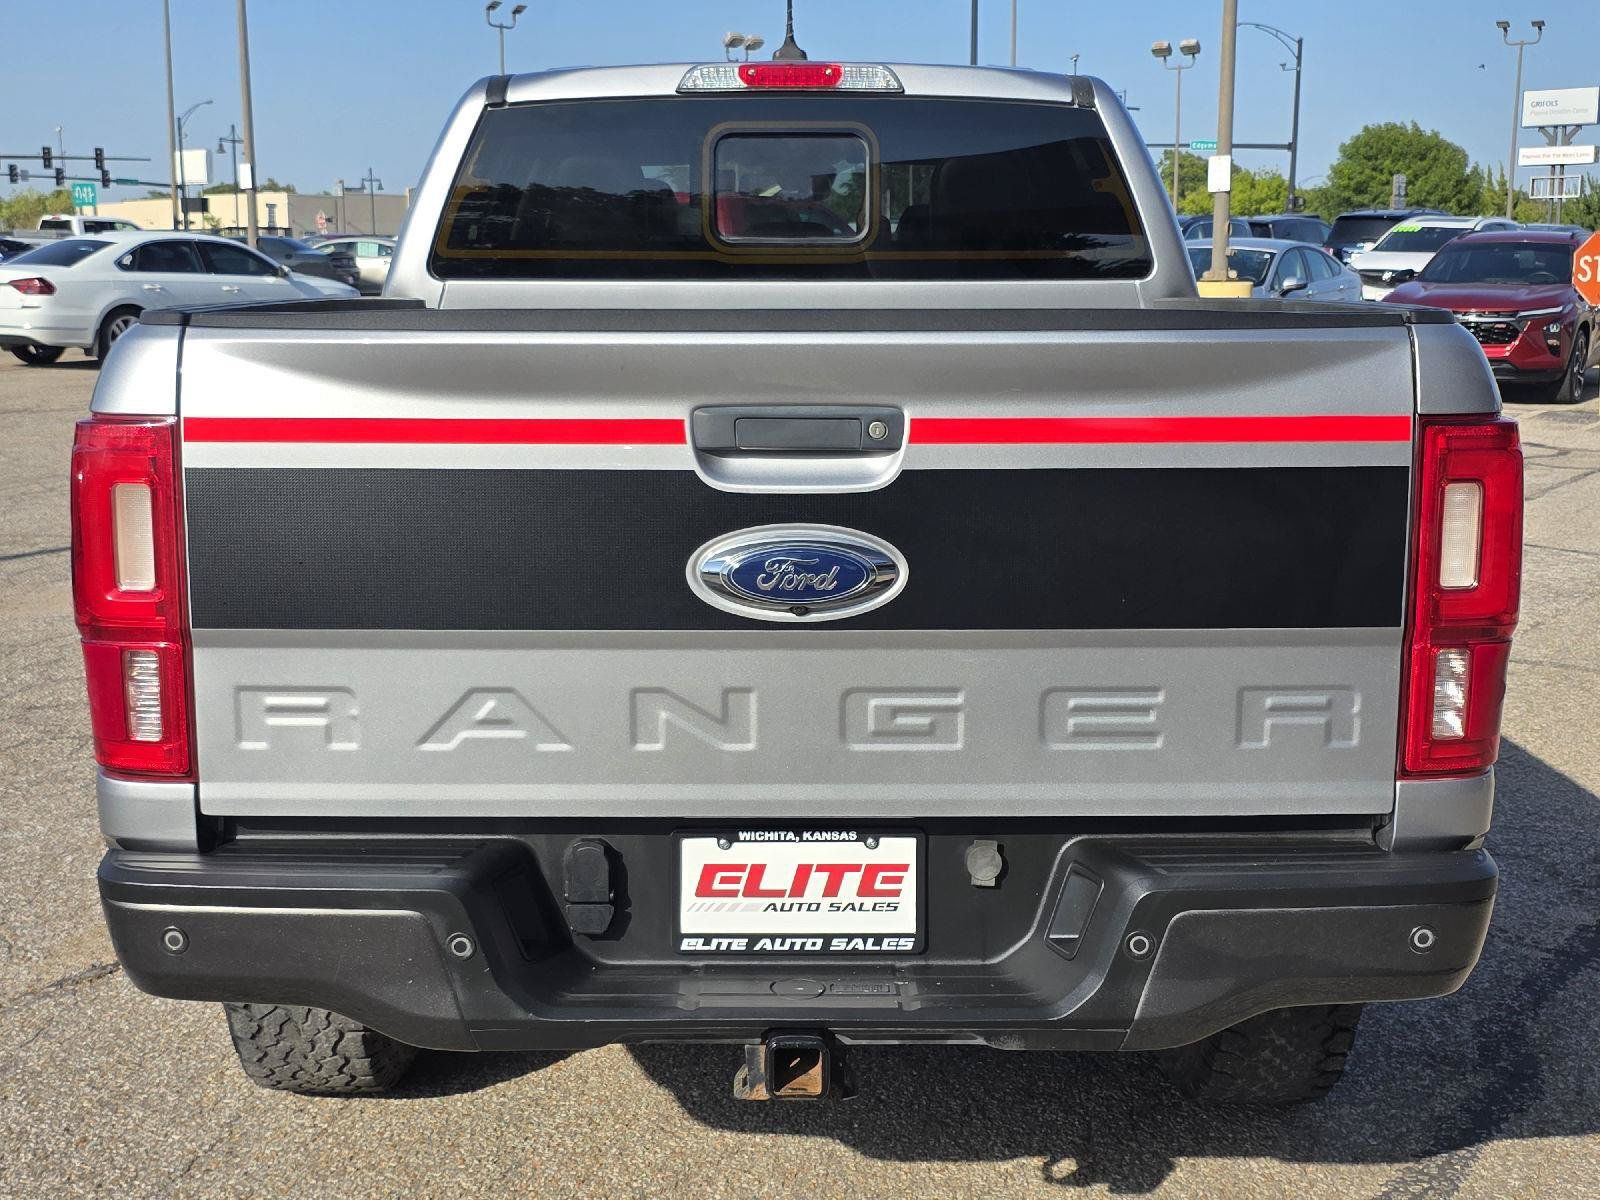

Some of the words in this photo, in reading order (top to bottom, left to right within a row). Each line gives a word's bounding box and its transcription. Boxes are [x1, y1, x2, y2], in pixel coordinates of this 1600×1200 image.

[757, 557, 840, 591] Ford
[234, 685, 1362, 752] RANGER
[738, 831, 799, 843] WICHITA,
[802, 831, 858, 841] KANSAS
[694, 863, 911, 898] ELITE
[762, 902, 822, 913] AUTO
[827, 902, 900, 912] SALES
[680, 937, 749, 951] ELITE
[753, 937, 824, 951] AUTO
[829, 937, 916, 951] SALES
